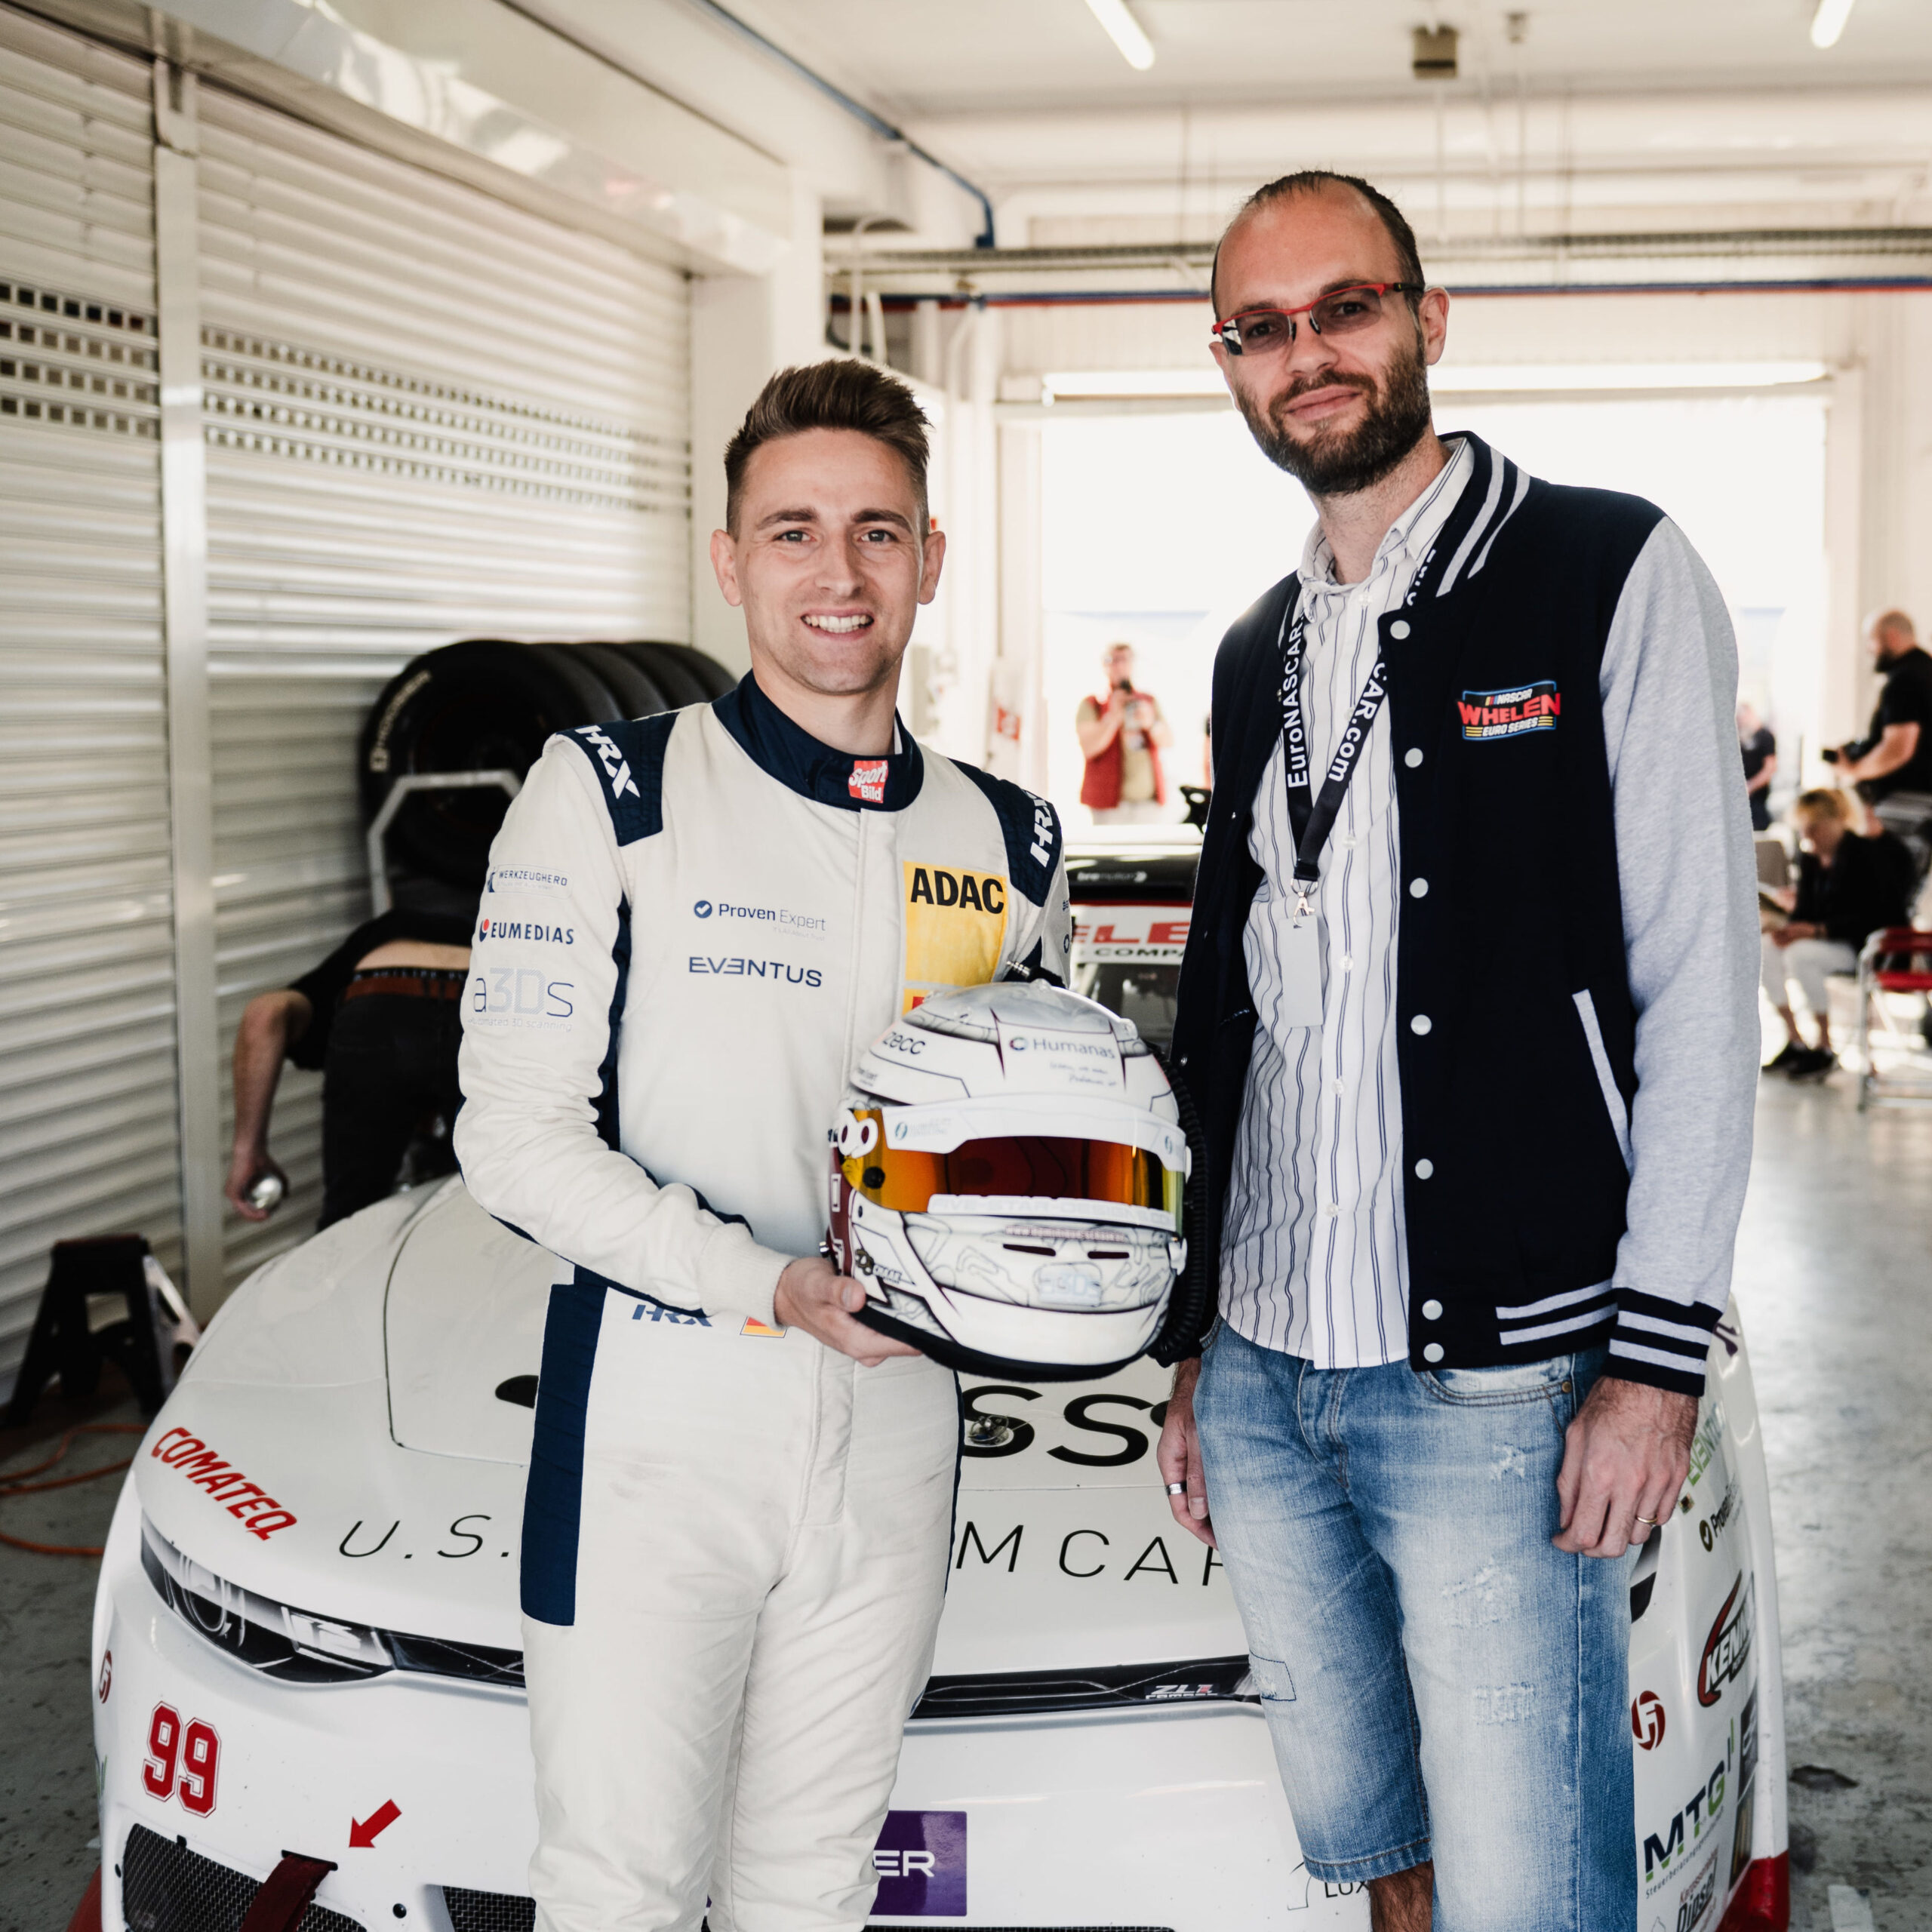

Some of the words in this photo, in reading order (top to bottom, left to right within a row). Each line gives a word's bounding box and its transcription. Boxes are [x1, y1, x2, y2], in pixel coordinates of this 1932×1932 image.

[1457, 693, 1561, 726] WHELEN
[1497, 688, 1533, 705] NASCAR
[1482, 724, 1507, 737] EURO
[1508, 717, 1538, 733] SERIES
[848, 761, 887, 788] Sport
[861, 785, 882, 801] Bild
[910, 867, 1004, 915] ADAC
[718, 903, 776, 921] Proven
[780, 909, 826, 931] Expert
[491, 921, 574, 944] EUMEDIAS
[689, 956, 823, 987] EVENTUS
[1033, 1038, 1115, 1059] Humanas
[150, 1427, 297, 1541] COMATEQ
[141, 1701, 222, 1819] 99
[1644, 1760, 1724, 1883] MTG
